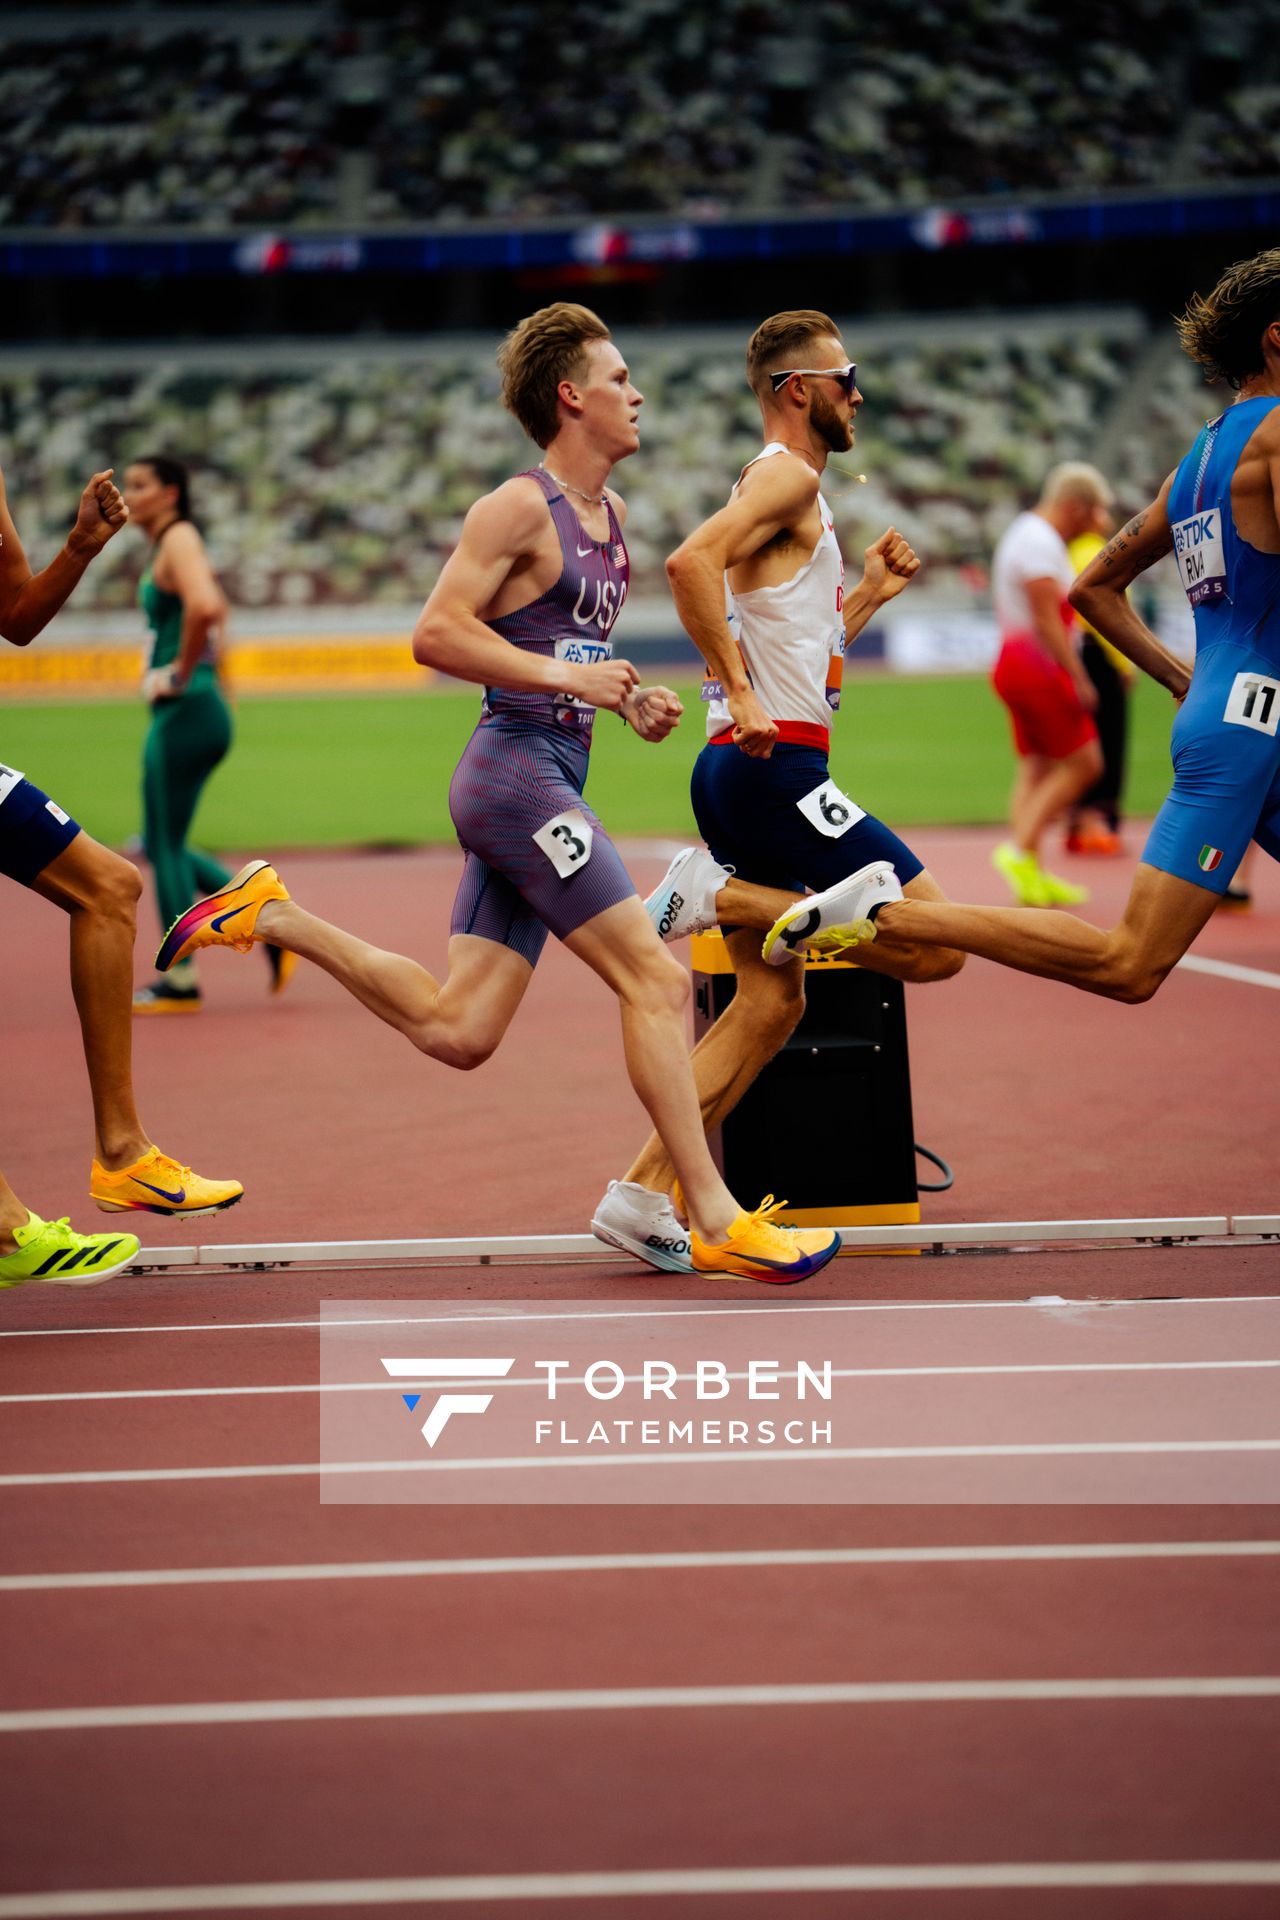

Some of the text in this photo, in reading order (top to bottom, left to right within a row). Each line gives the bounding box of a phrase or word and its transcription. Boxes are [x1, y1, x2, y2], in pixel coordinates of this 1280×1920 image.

[1183, 515, 1214, 548] TDK
[1243, 681, 1276, 724] 11
[819, 792, 849, 826] 6
[552, 825, 586, 862] 3
